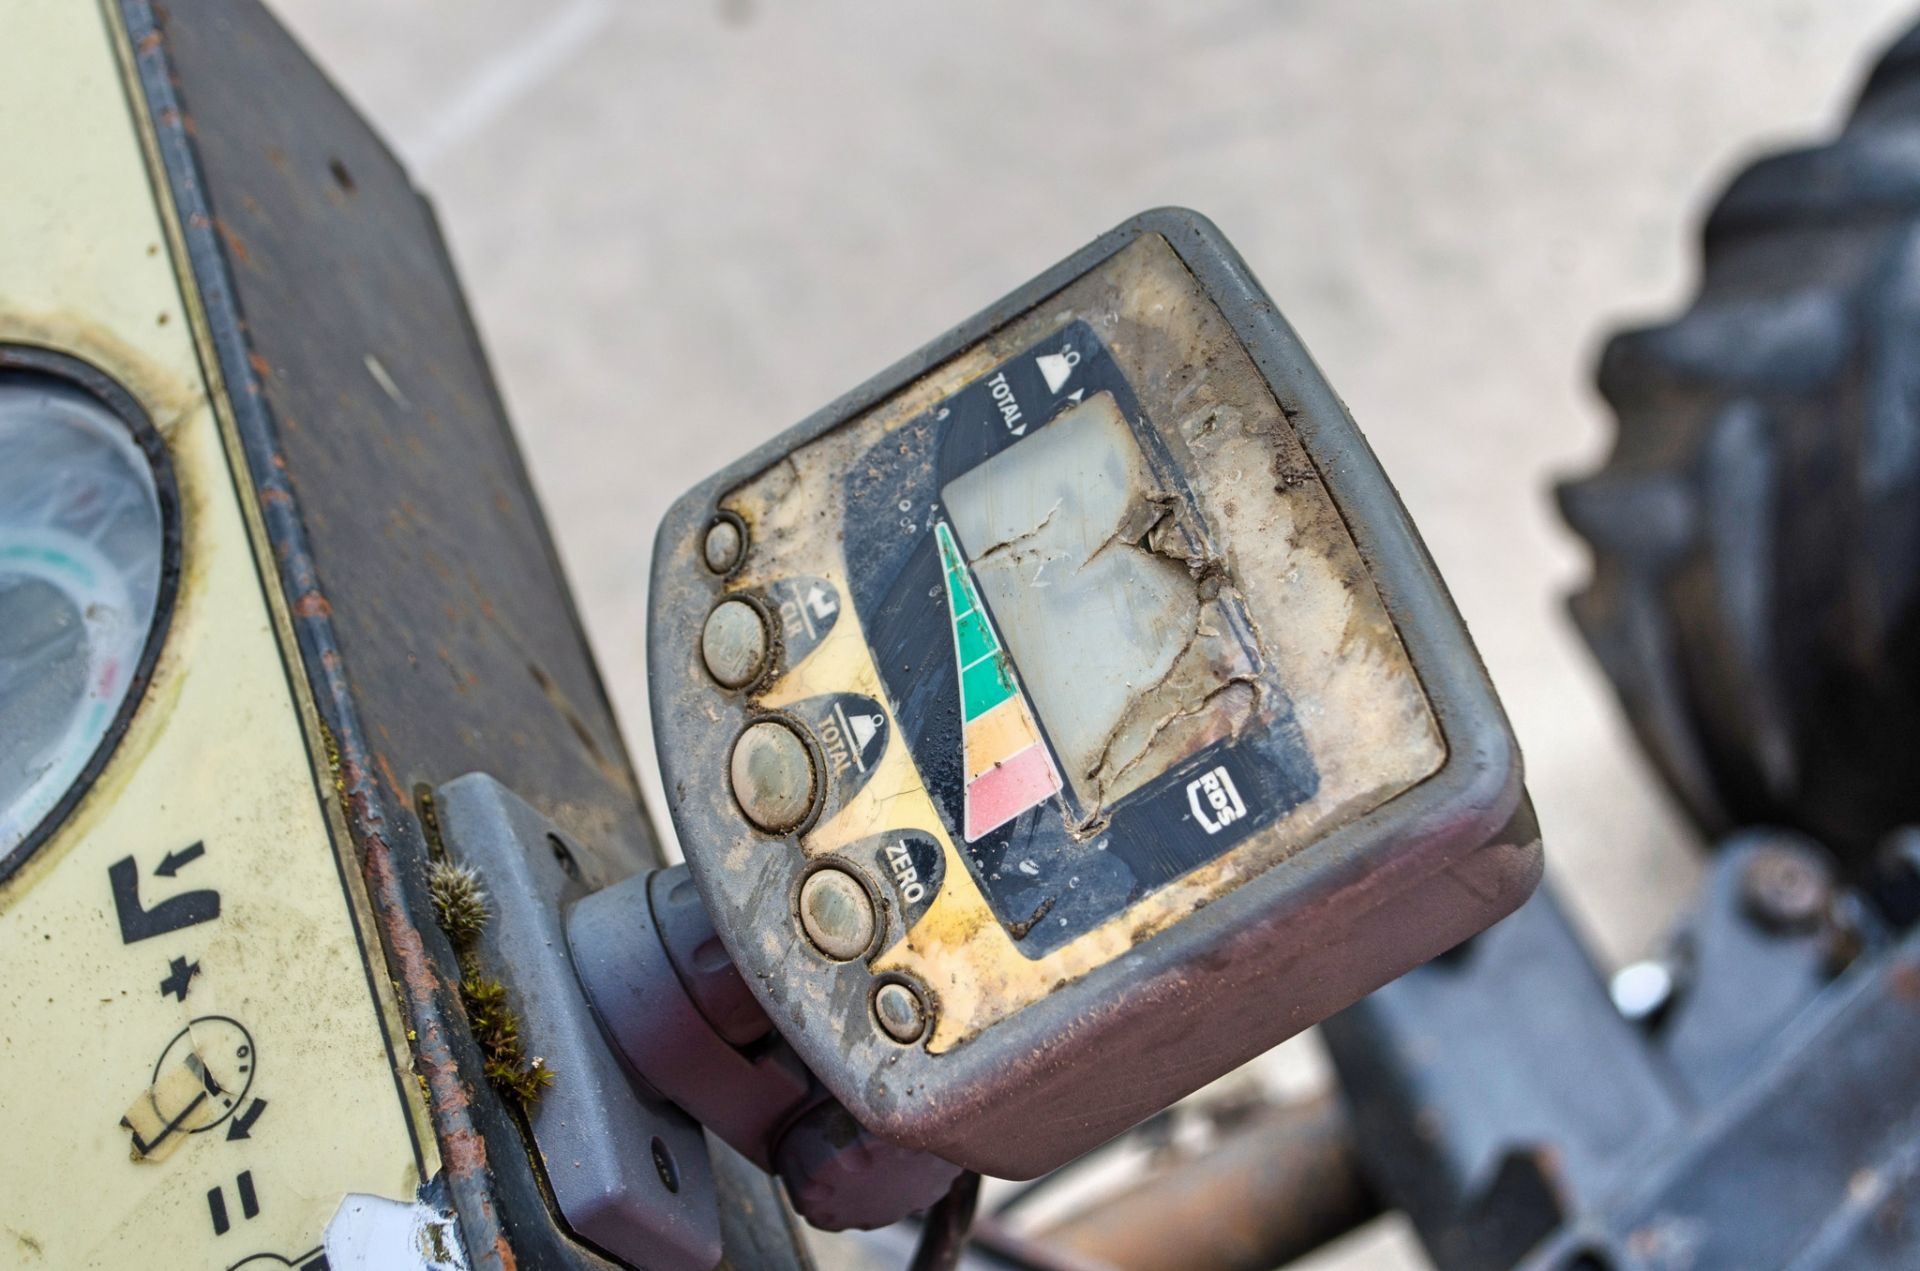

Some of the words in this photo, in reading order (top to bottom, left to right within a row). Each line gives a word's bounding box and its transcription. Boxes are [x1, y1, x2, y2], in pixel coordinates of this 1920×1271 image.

[988, 372, 1022, 429] TOTAL
[818, 714, 852, 779] TOTAL
[885, 839, 924, 903] ZERO
